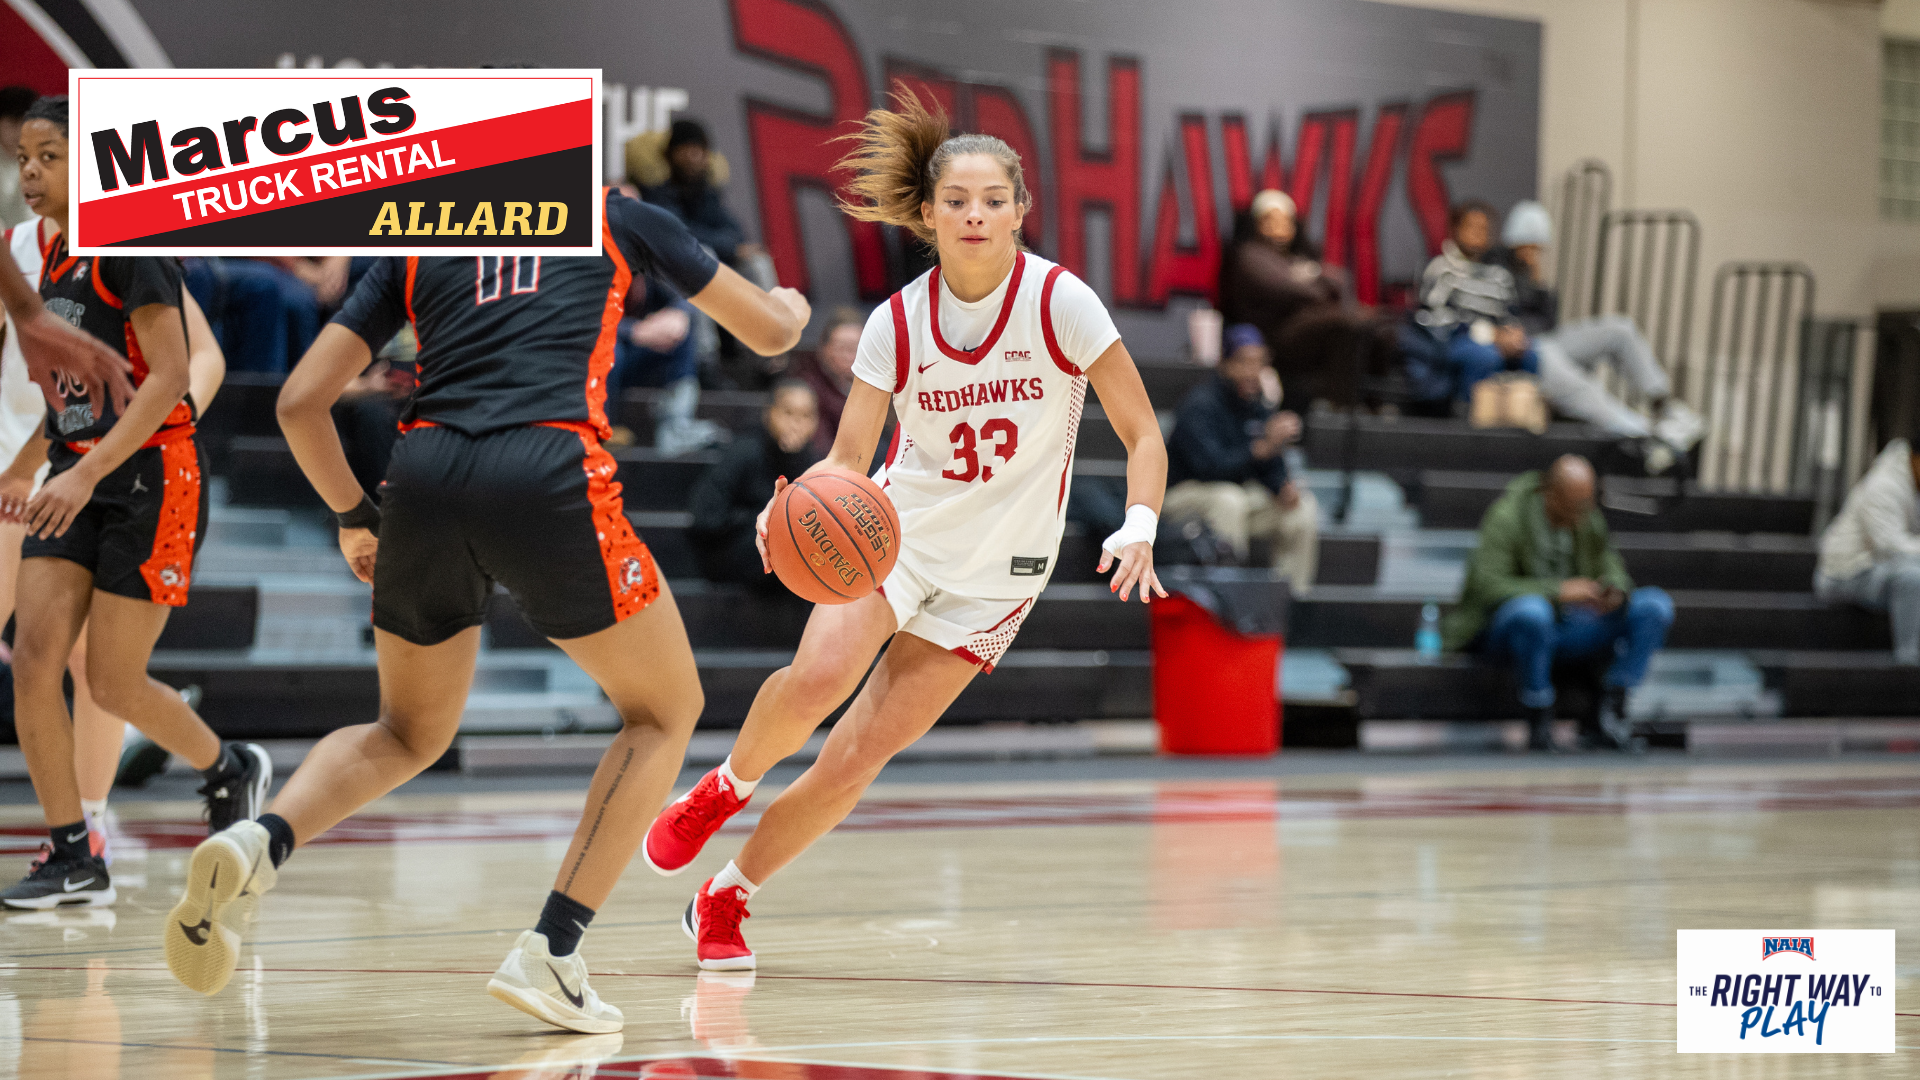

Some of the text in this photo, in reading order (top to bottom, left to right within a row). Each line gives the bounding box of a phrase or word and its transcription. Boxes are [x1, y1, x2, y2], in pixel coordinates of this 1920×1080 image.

[918, 377, 1043, 412] REDHAWKS
[942, 418, 1018, 483] 33
[798, 508, 864, 586] SPALDING
[834, 495, 886, 562] LEGACY
[1037, 562, 1045, 570] M
